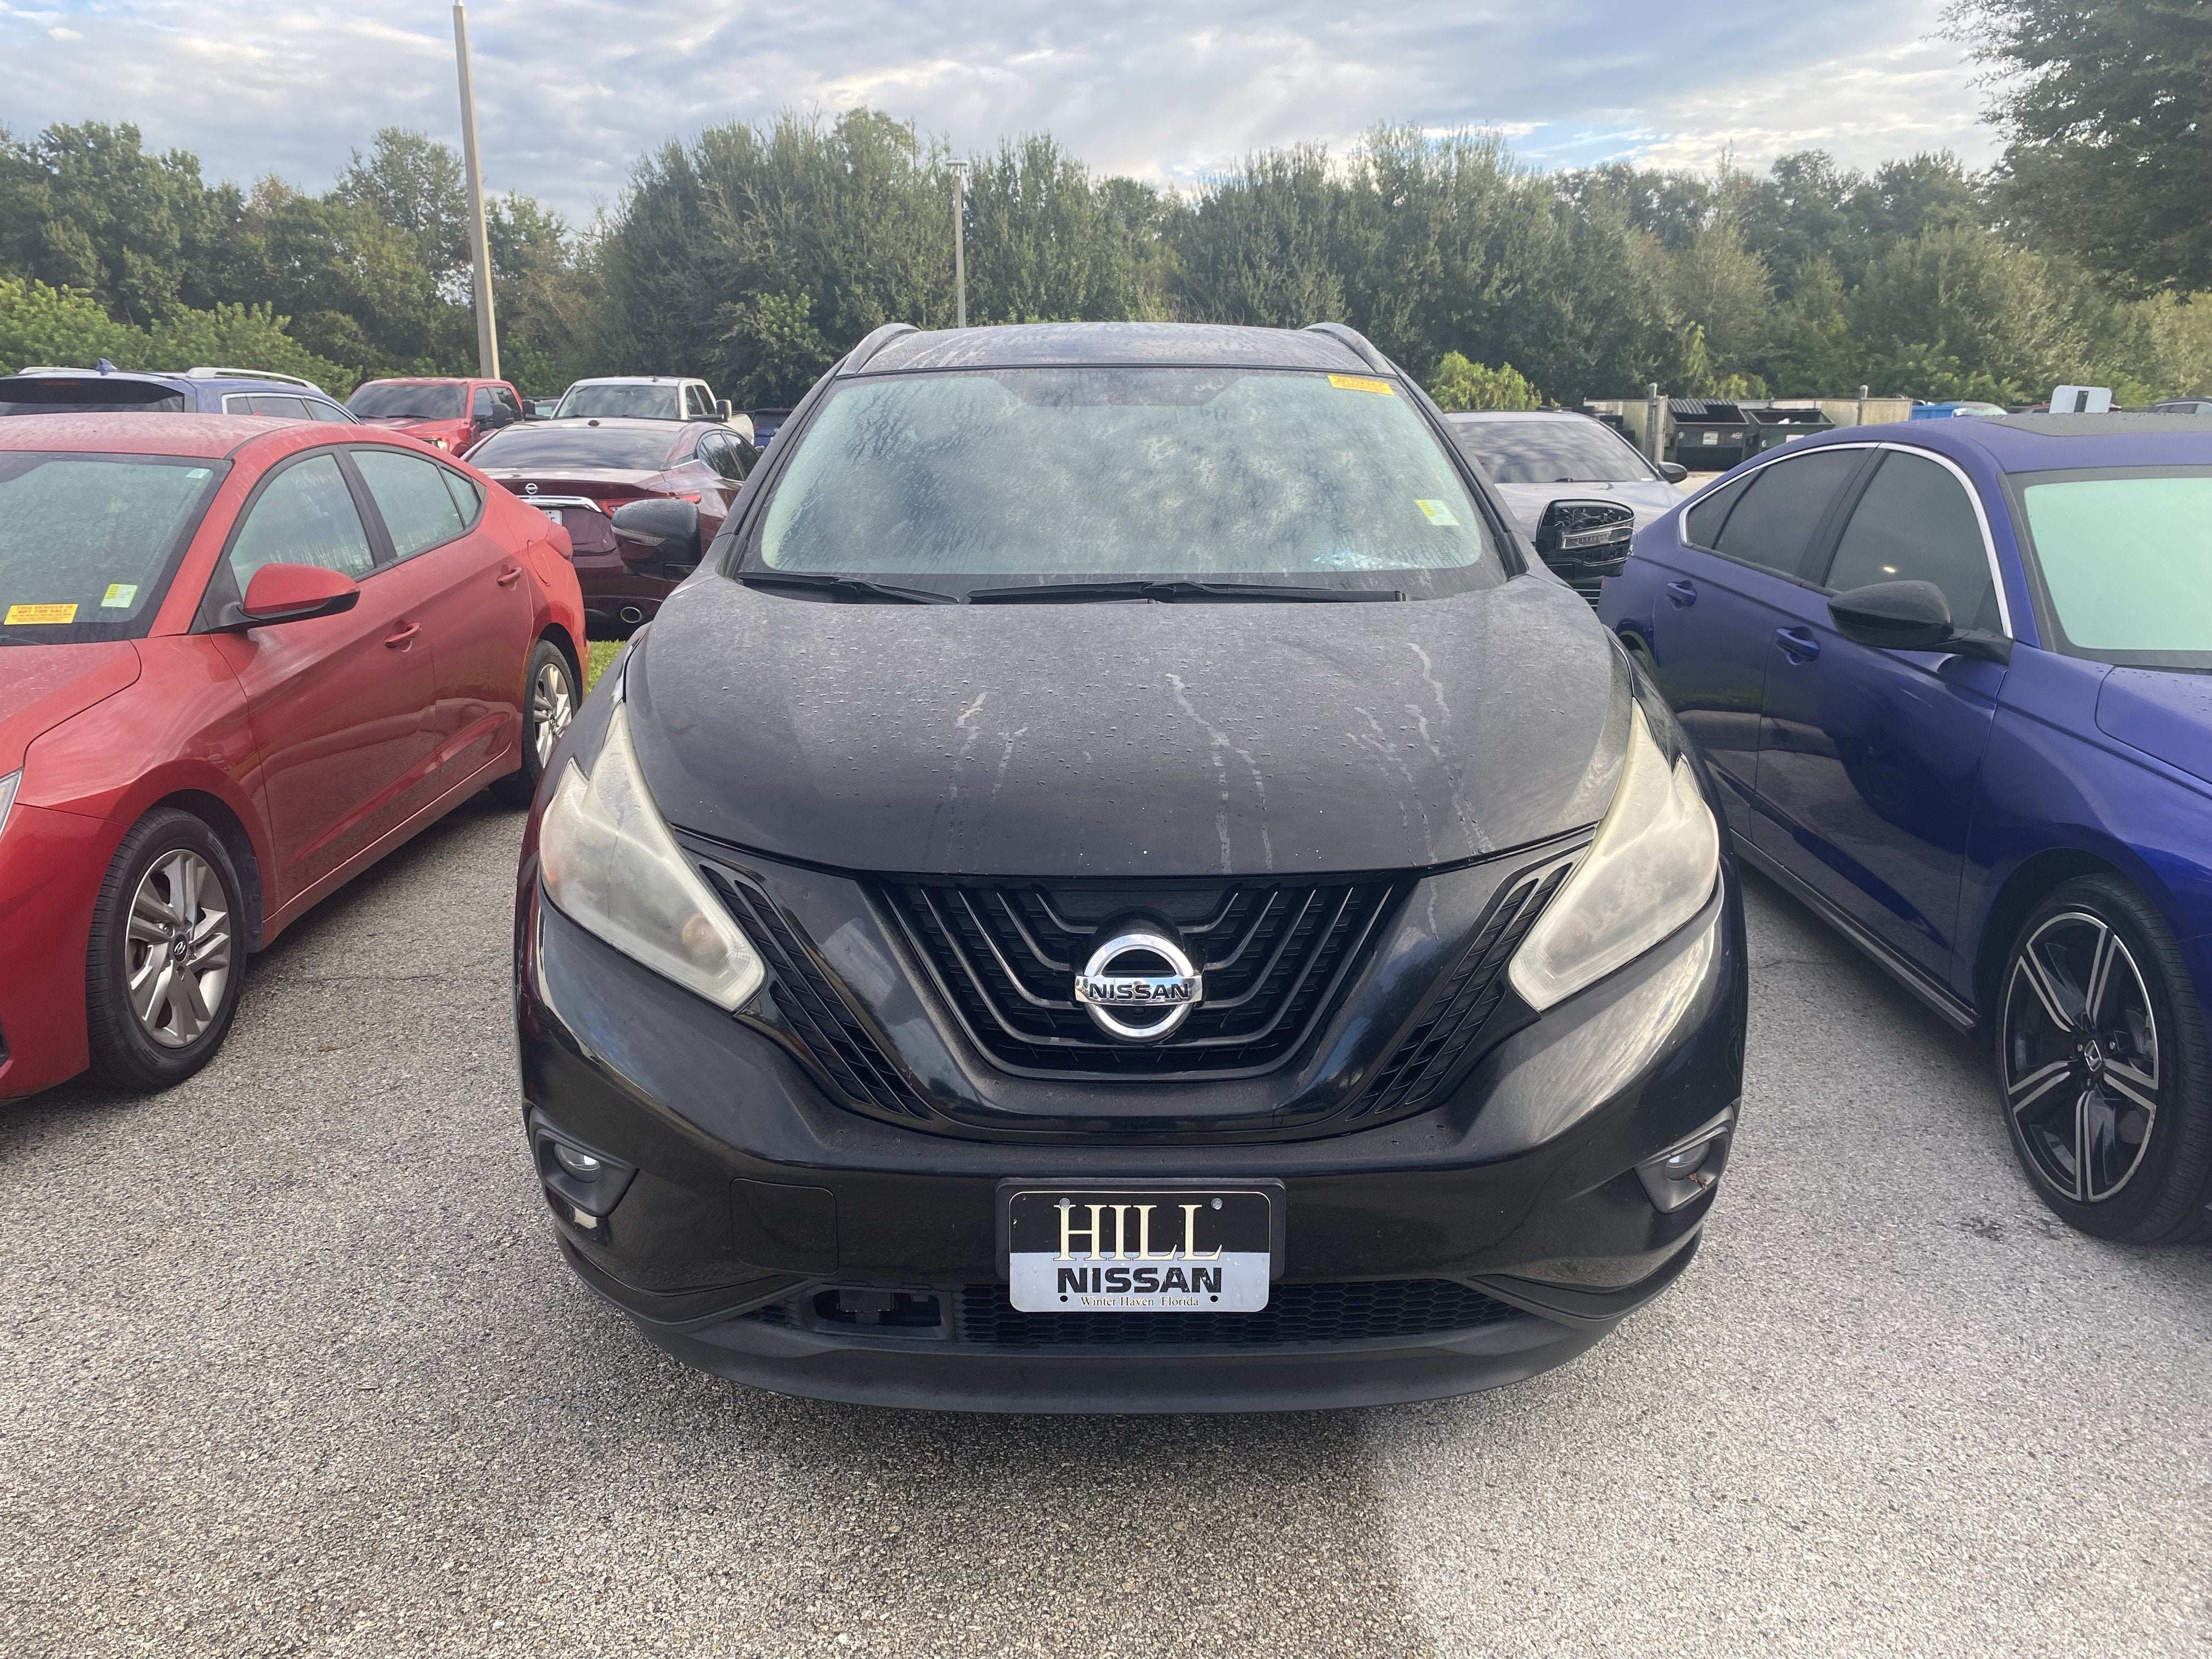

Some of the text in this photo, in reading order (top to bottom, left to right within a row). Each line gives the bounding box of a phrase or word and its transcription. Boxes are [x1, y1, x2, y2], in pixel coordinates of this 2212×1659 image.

[1089, 983, 1189, 1000] NISSAN
[1053, 1204, 1222, 1261] HILL
[1057, 1267, 1222, 1294] NISSAN
[1080, 1296, 1199, 1307] Winter Haven Florida
